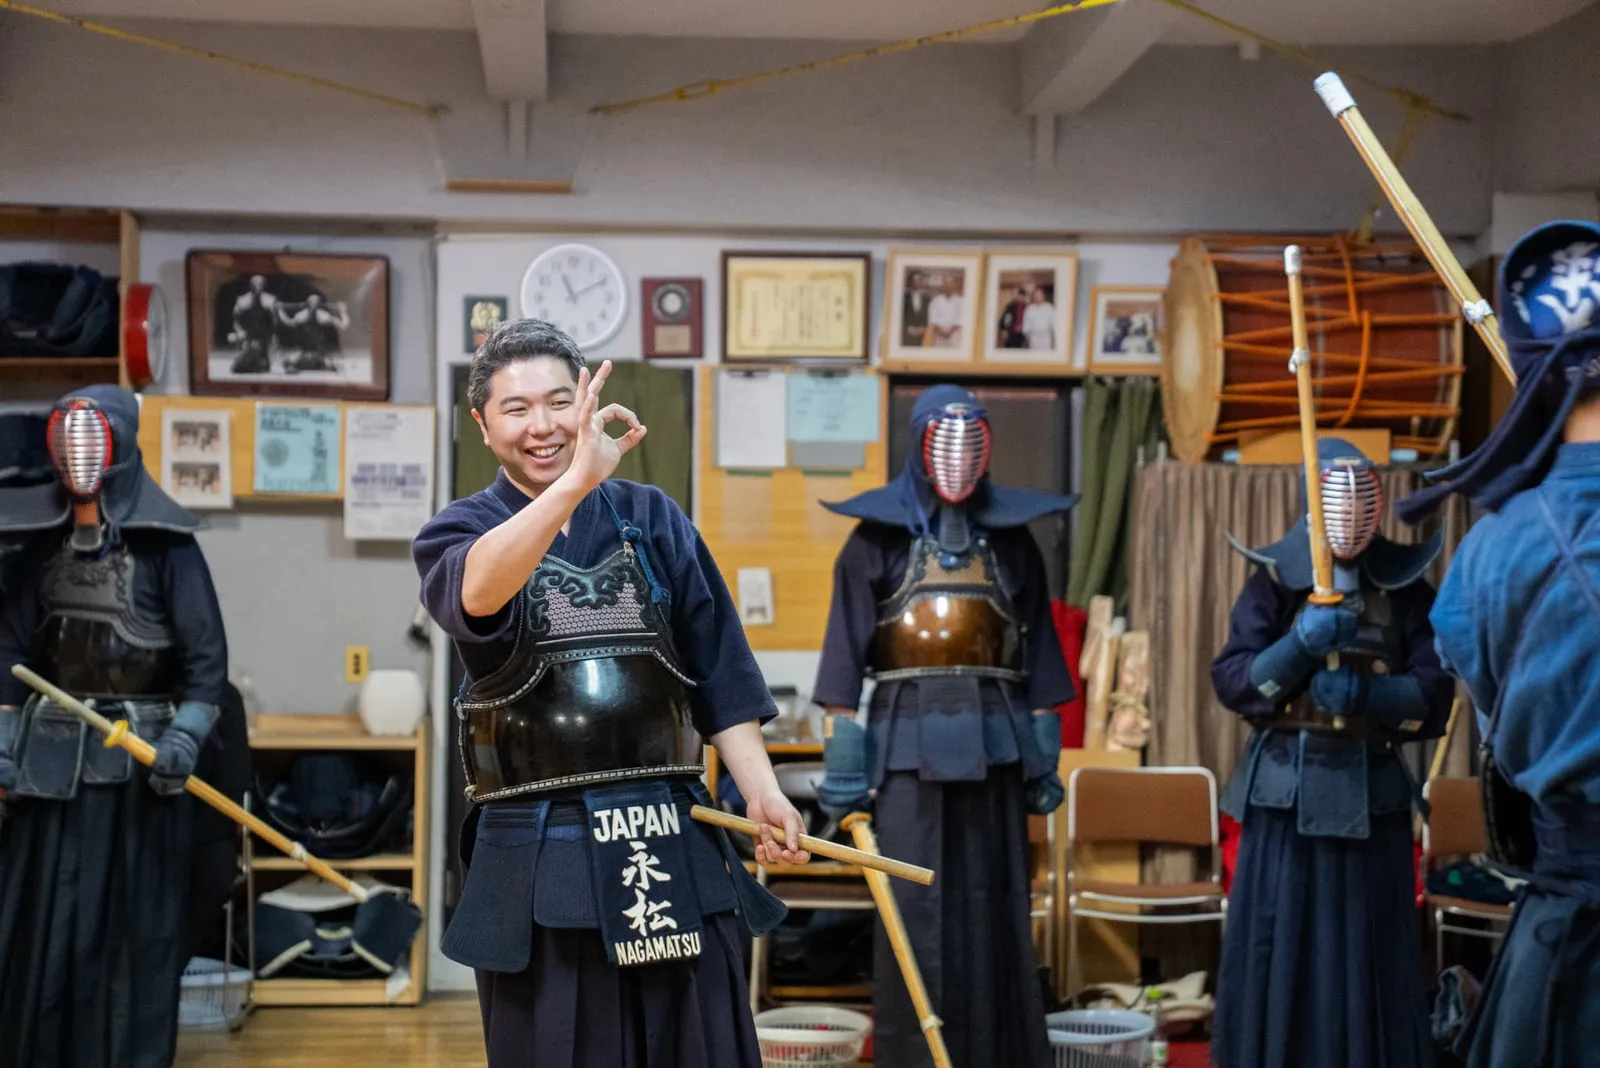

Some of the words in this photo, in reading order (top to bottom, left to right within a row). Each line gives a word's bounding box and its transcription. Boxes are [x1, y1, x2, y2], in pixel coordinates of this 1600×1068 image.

[593, 803, 680, 842] JAPAN
[622, 841, 677, 937] 永松
[614, 932, 701, 966] NAGAMATSU
